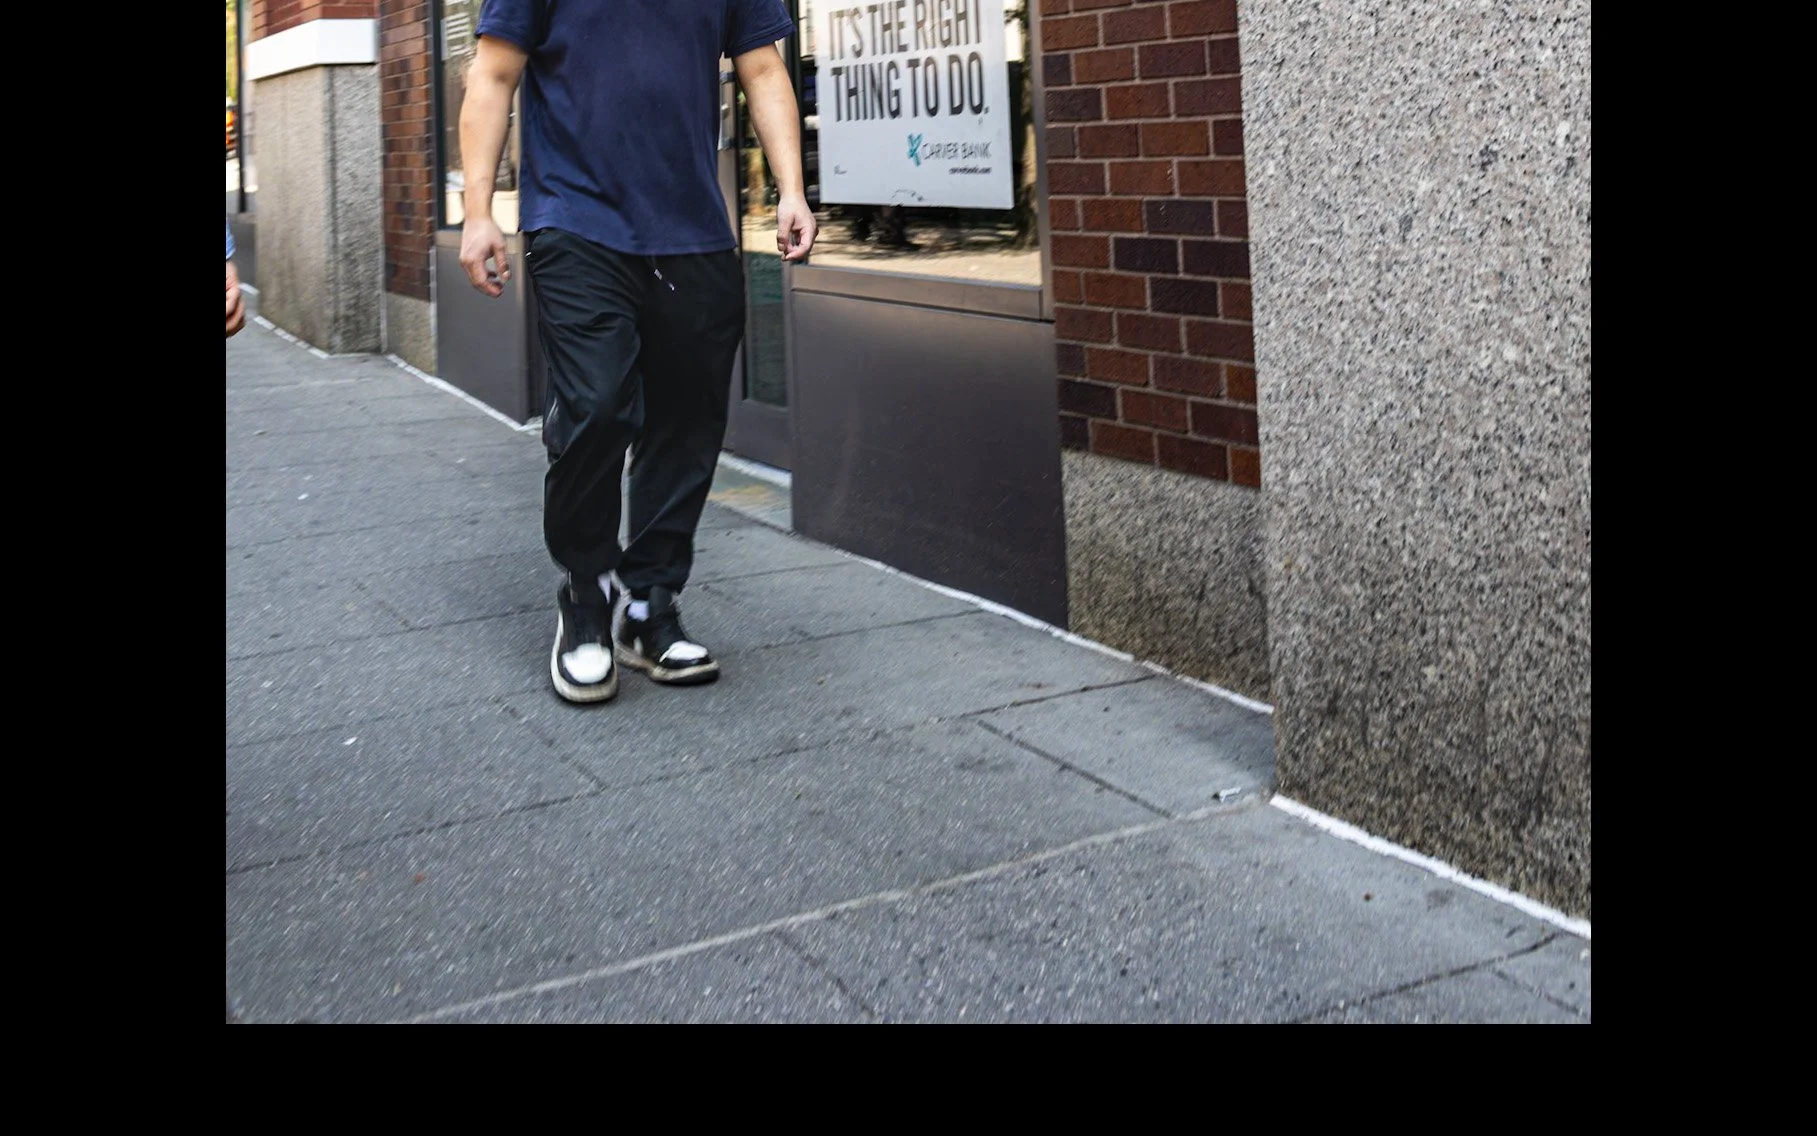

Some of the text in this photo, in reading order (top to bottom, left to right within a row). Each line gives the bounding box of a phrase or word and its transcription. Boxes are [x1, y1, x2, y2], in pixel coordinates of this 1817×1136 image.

[828, 7, 863, 60] IT'S
[831, 51, 989, 121] THING TO DO.
[922, 141, 992, 160] CARVER BANK
